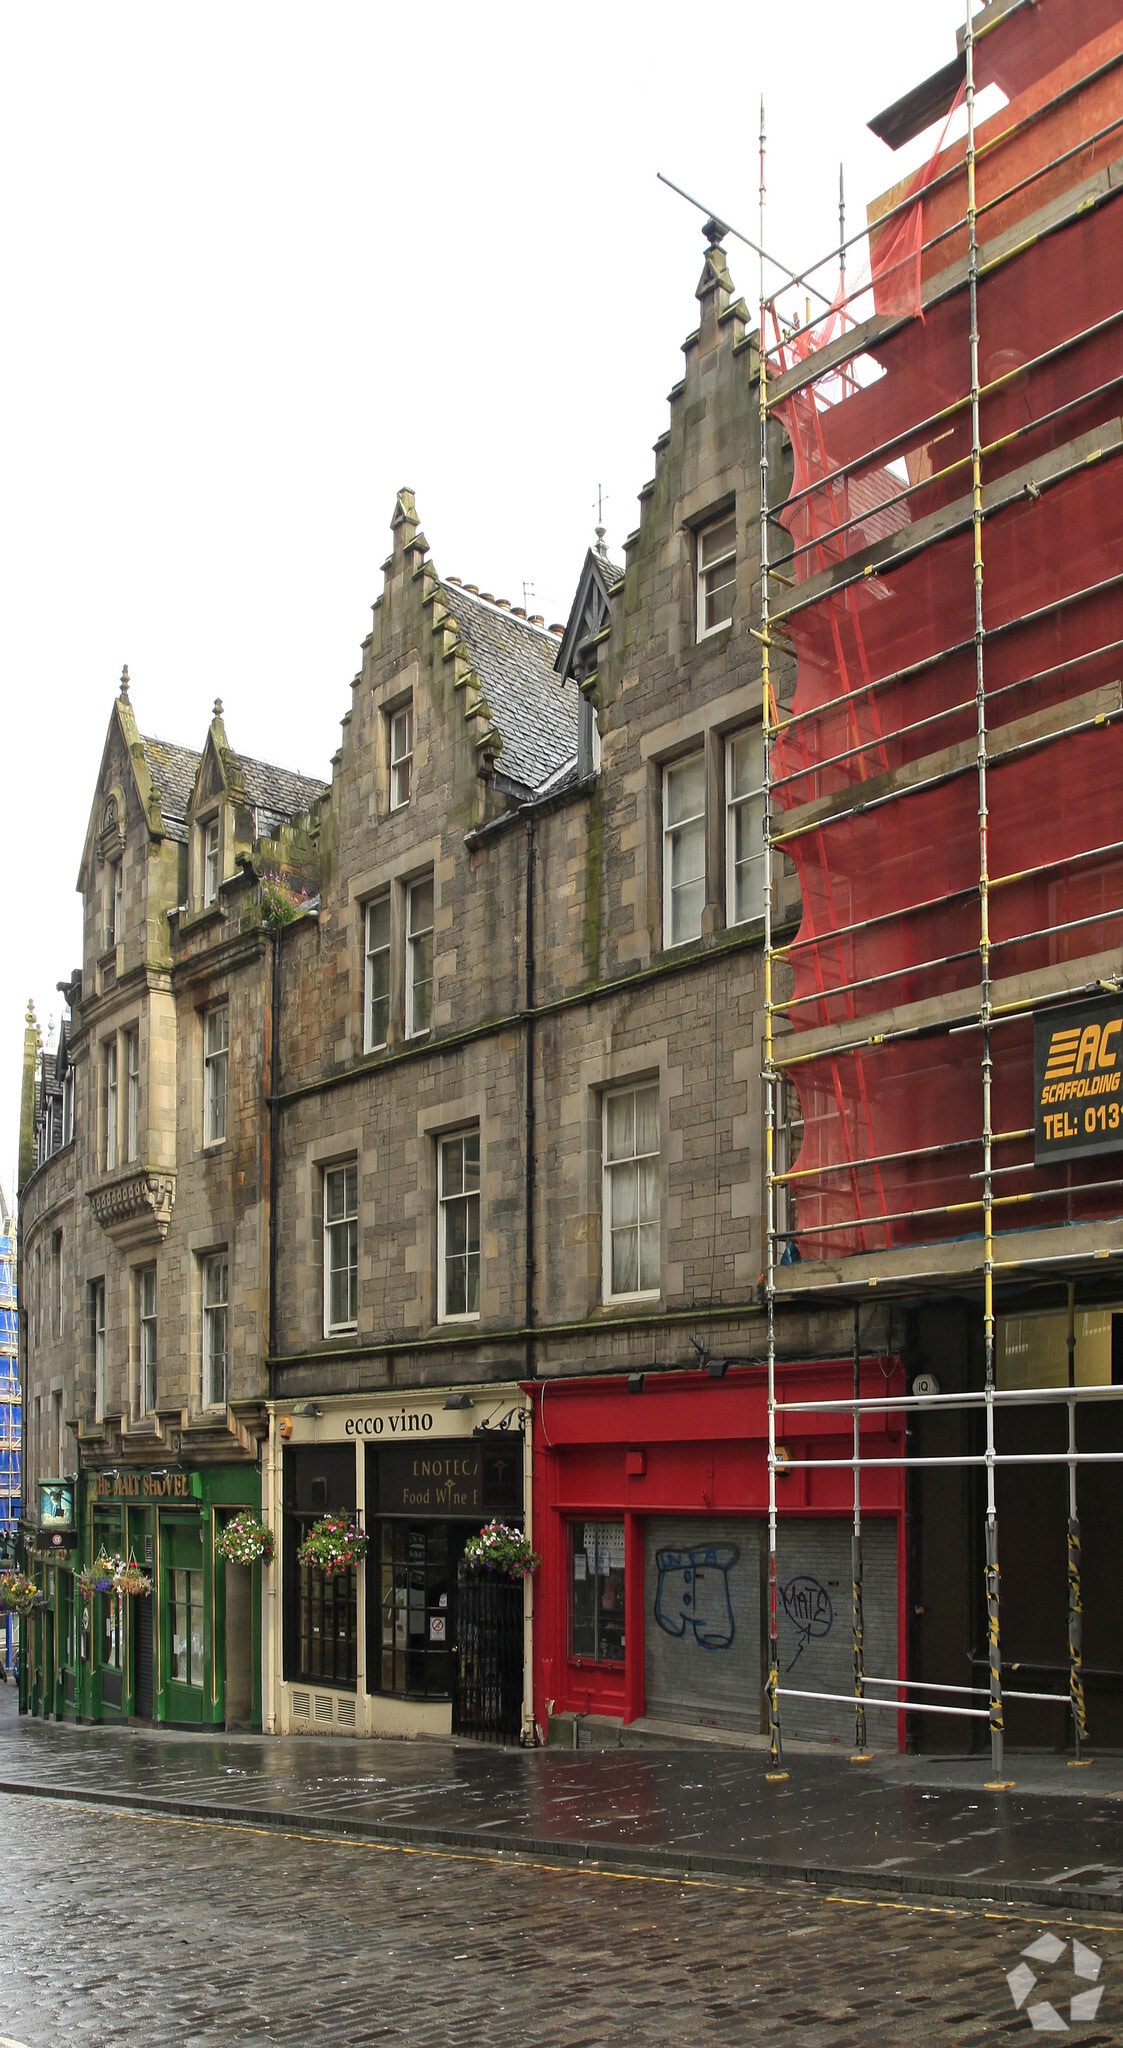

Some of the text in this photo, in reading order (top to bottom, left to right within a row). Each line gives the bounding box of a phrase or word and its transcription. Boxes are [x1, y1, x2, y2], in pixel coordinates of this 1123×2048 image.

[1041, 1071, 1121, 1104] SCAFFOLDING
[1043, 1111, 1078, 1140] TEL:
[345, 1408, 434, 1435] ecco vino
[143, 1474, 190, 1496] SHOVEL
[403, 1487, 430, 1504] Food
[779, 1585, 828, 1624] MATE
